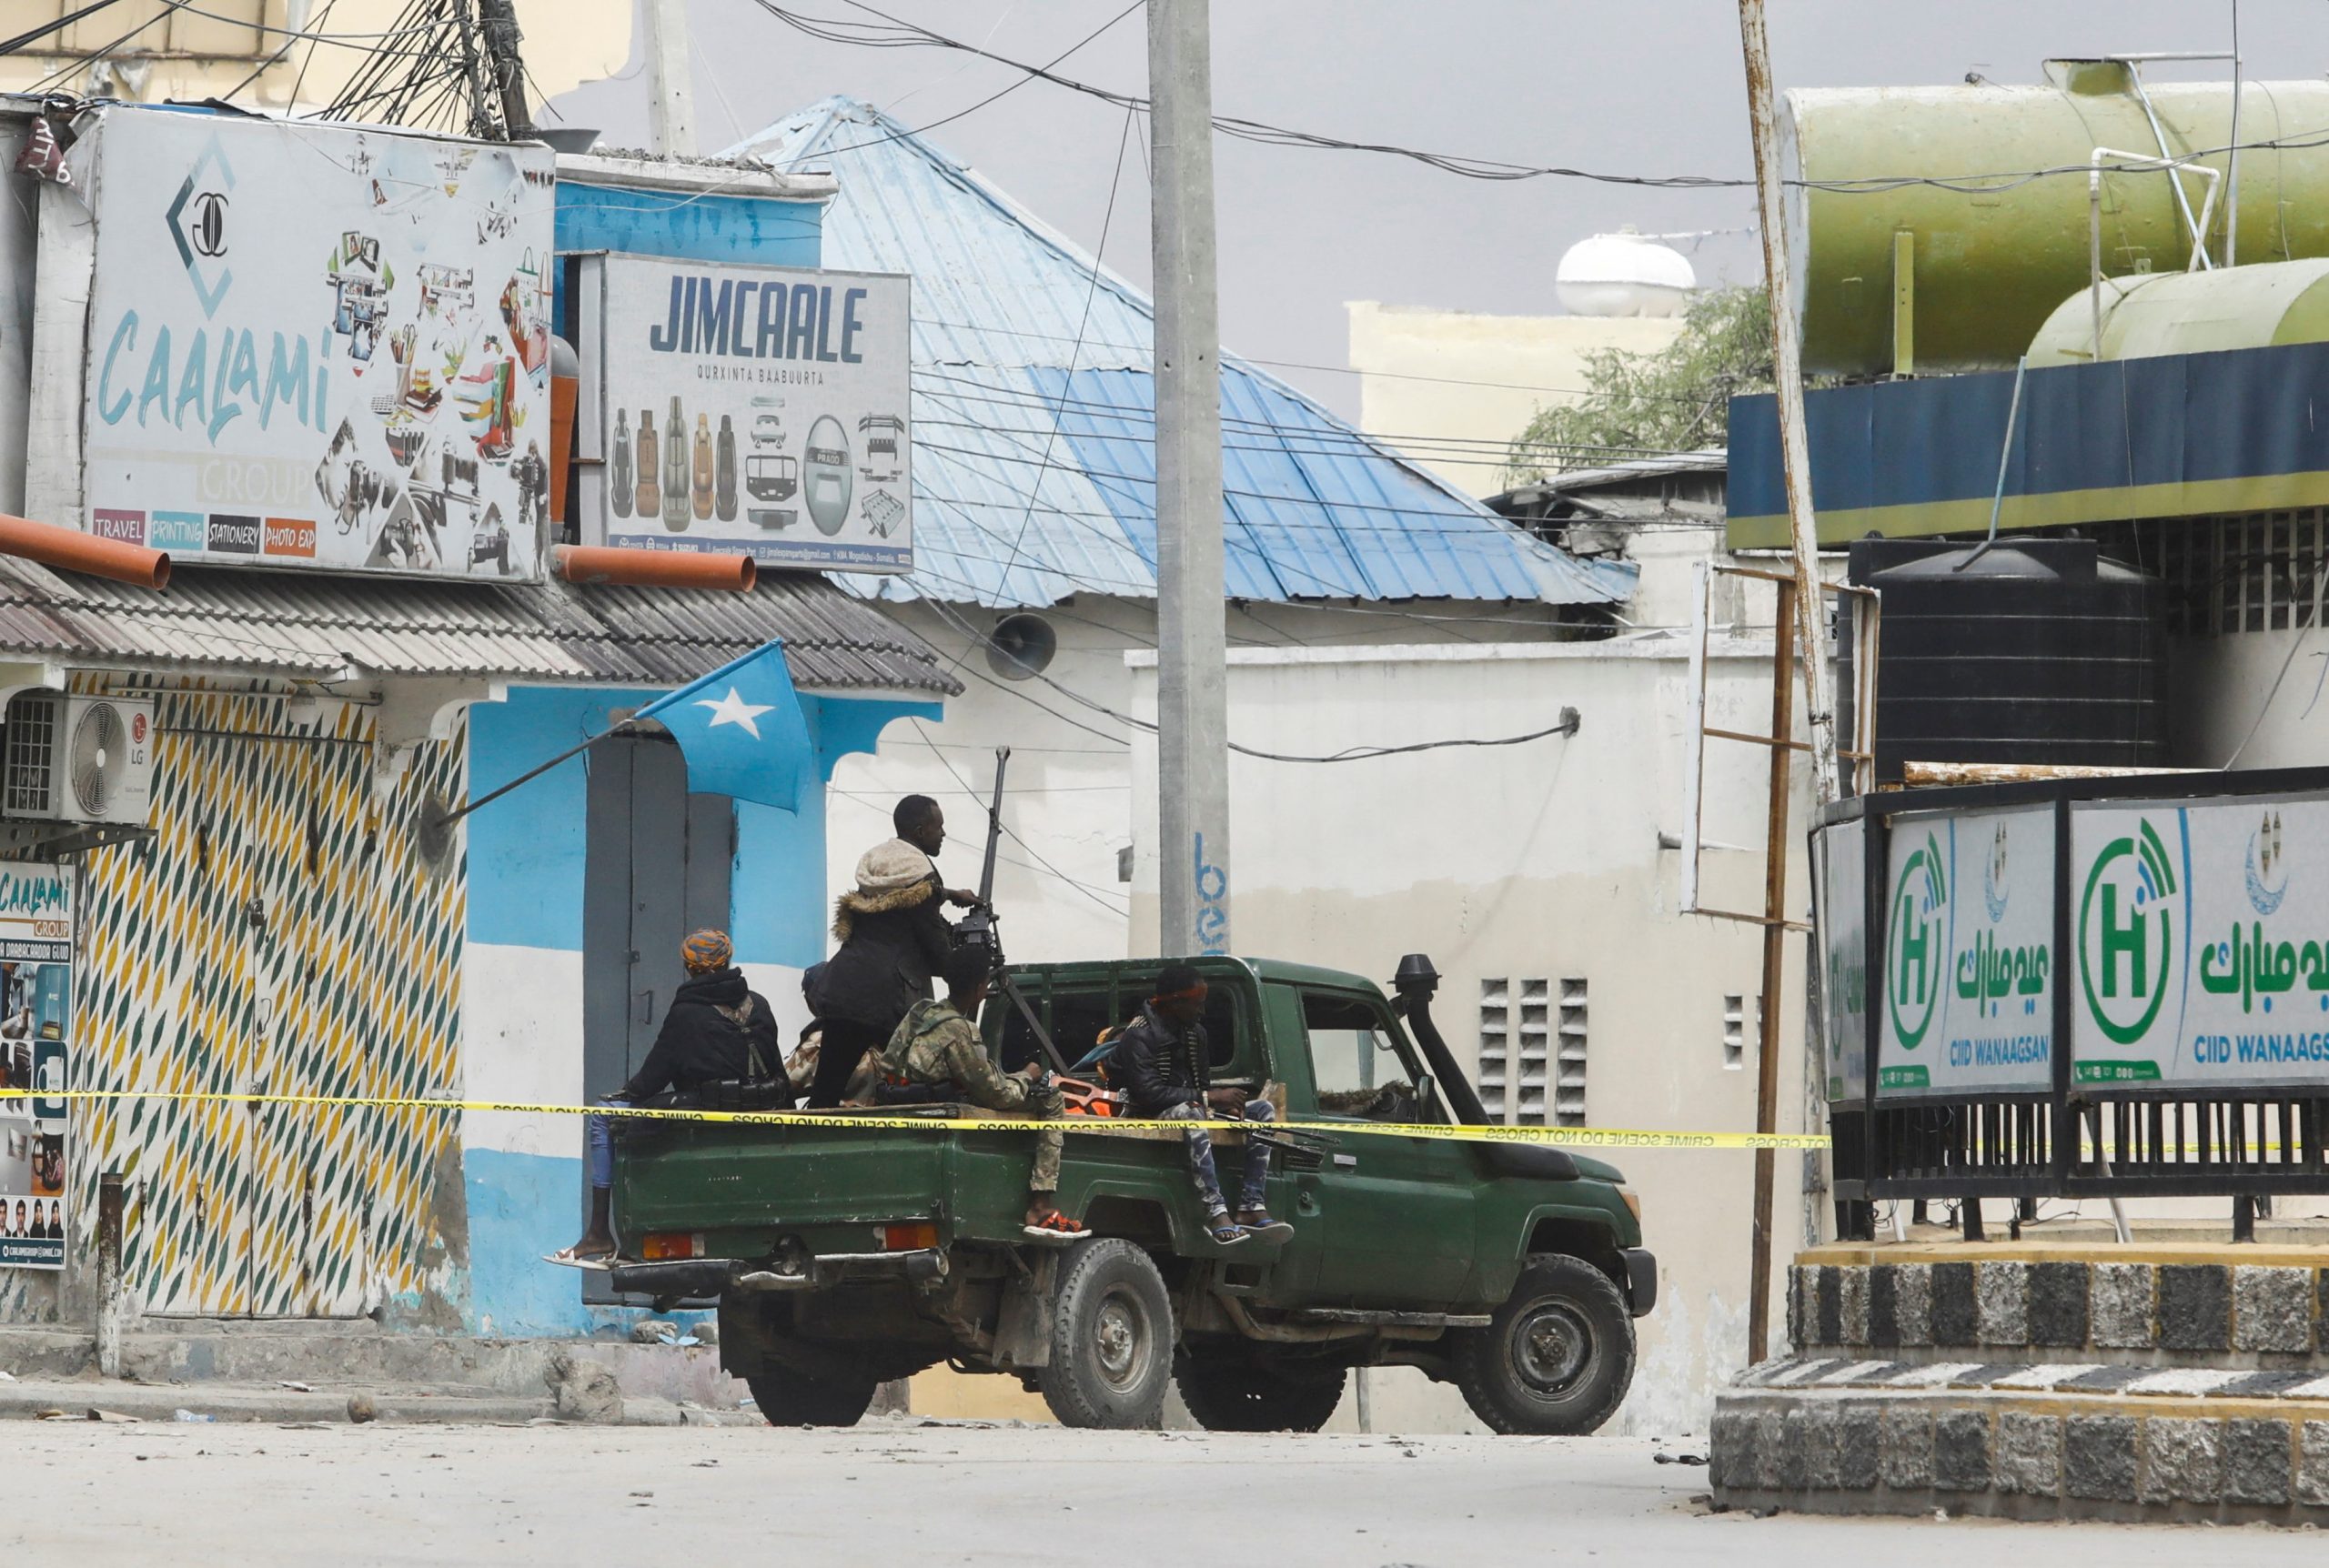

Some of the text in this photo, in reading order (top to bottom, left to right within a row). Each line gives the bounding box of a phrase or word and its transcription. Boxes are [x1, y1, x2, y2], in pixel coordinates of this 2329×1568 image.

[650, 276, 867, 364] JIMCAALE
[98, 309, 333, 447] CAALAMI
[697, 365, 825, 387] QURXINTA BAABUURTA
[817, 453, 840, 465] PRADO
[202, 460, 314, 505] GROUP
[95, 518, 143, 539] TRAVEL
[151, 519, 202, 543] PRINTING
[208, 520, 259, 548] STATIONERY
[266, 527, 316, 552] PHOTO EXP
[131, 749, 144, 765] LG
[35, 921, 69, 937] GROUP
[1950, 1034, 2049, 1066] CIID WANAAGSAN
[2194, 1035, 2231, 1063] CIID
